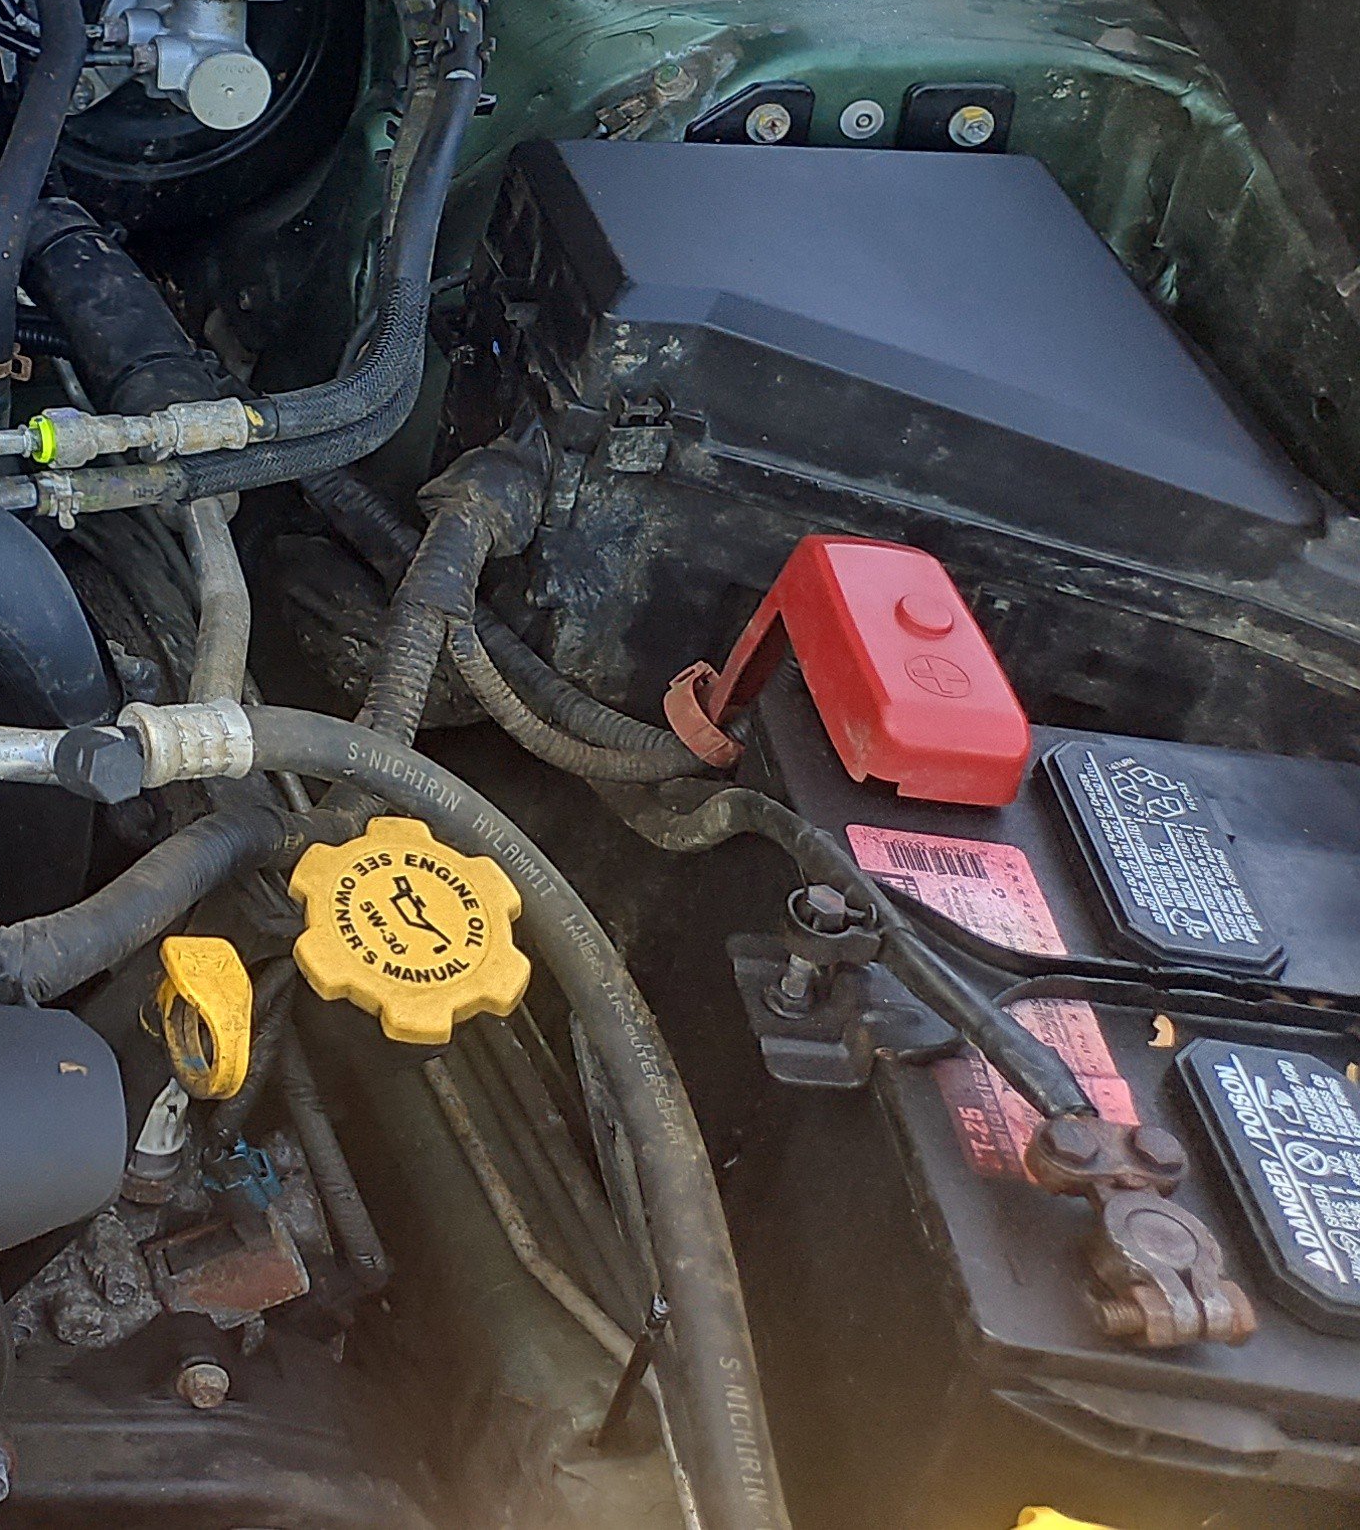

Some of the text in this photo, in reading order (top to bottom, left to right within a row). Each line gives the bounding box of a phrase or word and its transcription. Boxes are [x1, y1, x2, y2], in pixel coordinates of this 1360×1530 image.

[472, 812, 559, 898] HYLAMMIT
[1108, 842, 1125, 858] THE
[1115, 858, 1131, 870] OF
[1121, 870, 1139, 887] OUT
[1143, 863, 1164, 883] EYES
[1158, 841, 1203, 911] MEDICAL HELP FAST
[403, 853, 485, 949] ENGINE OIL
[1142, 894, 1159, 911] NOT
[1152, 881, 1176, 907] FLUSH
[1168, 888, 1189, 908] WITH
[335, 853, 470, 984] SEE OWNER'S MANUAL
[359, 900, 409, 955] 5W-30
[1150, 911, 1166, 924] DO
[1212, 1064, 1271, 1141] POISON
[1323, 1153, 1349, 1175] NO
[1256, 1157, 1323, 1249] DANGER
[1307, 1186, 1343, 1228] SHIELD
[1328, 1199, 1360, 1230] EYES
